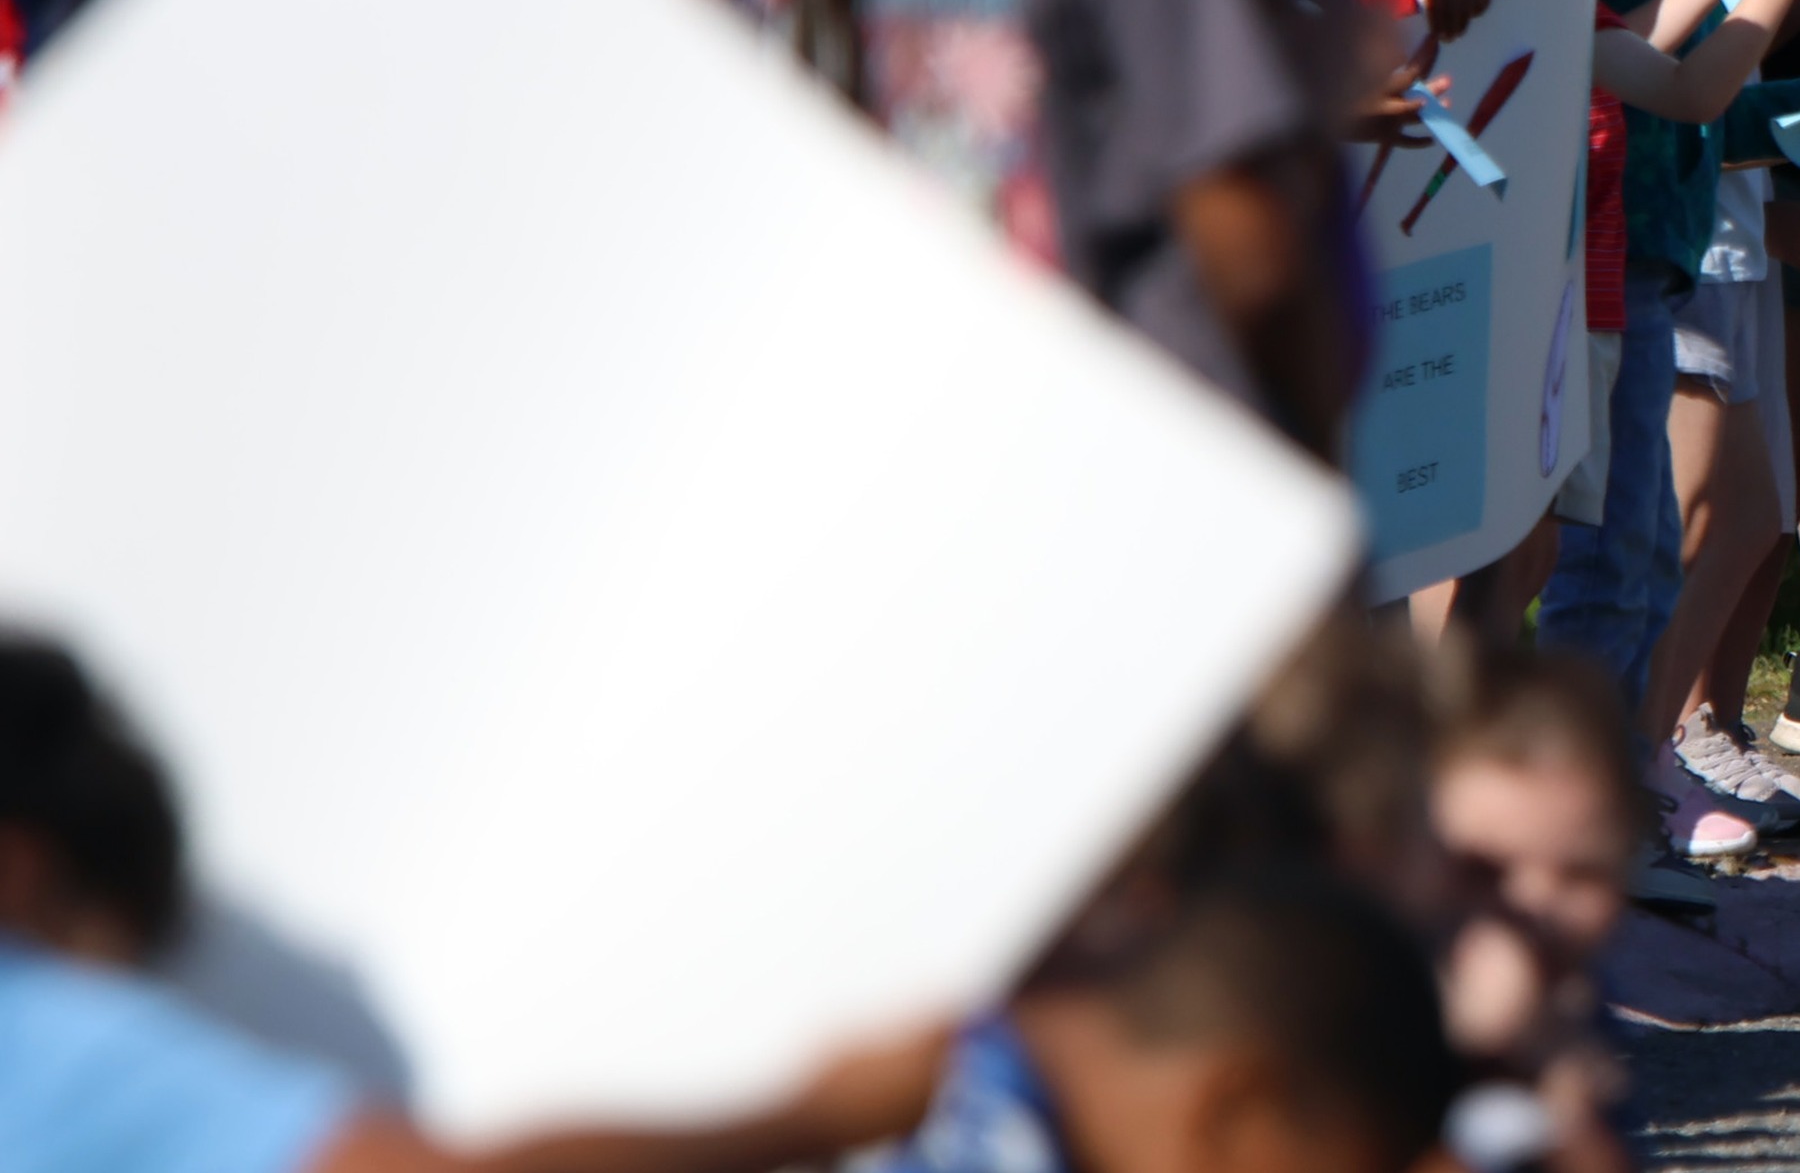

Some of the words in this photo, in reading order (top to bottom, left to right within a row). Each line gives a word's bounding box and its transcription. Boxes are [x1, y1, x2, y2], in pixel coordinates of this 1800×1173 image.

[1408, 282, 1466, 315] BEARS
[1382, 364, 1416, 392] ARE
[1421, 353, 1455, 381] THE
[1396, 460, 1440, 495] BEST
